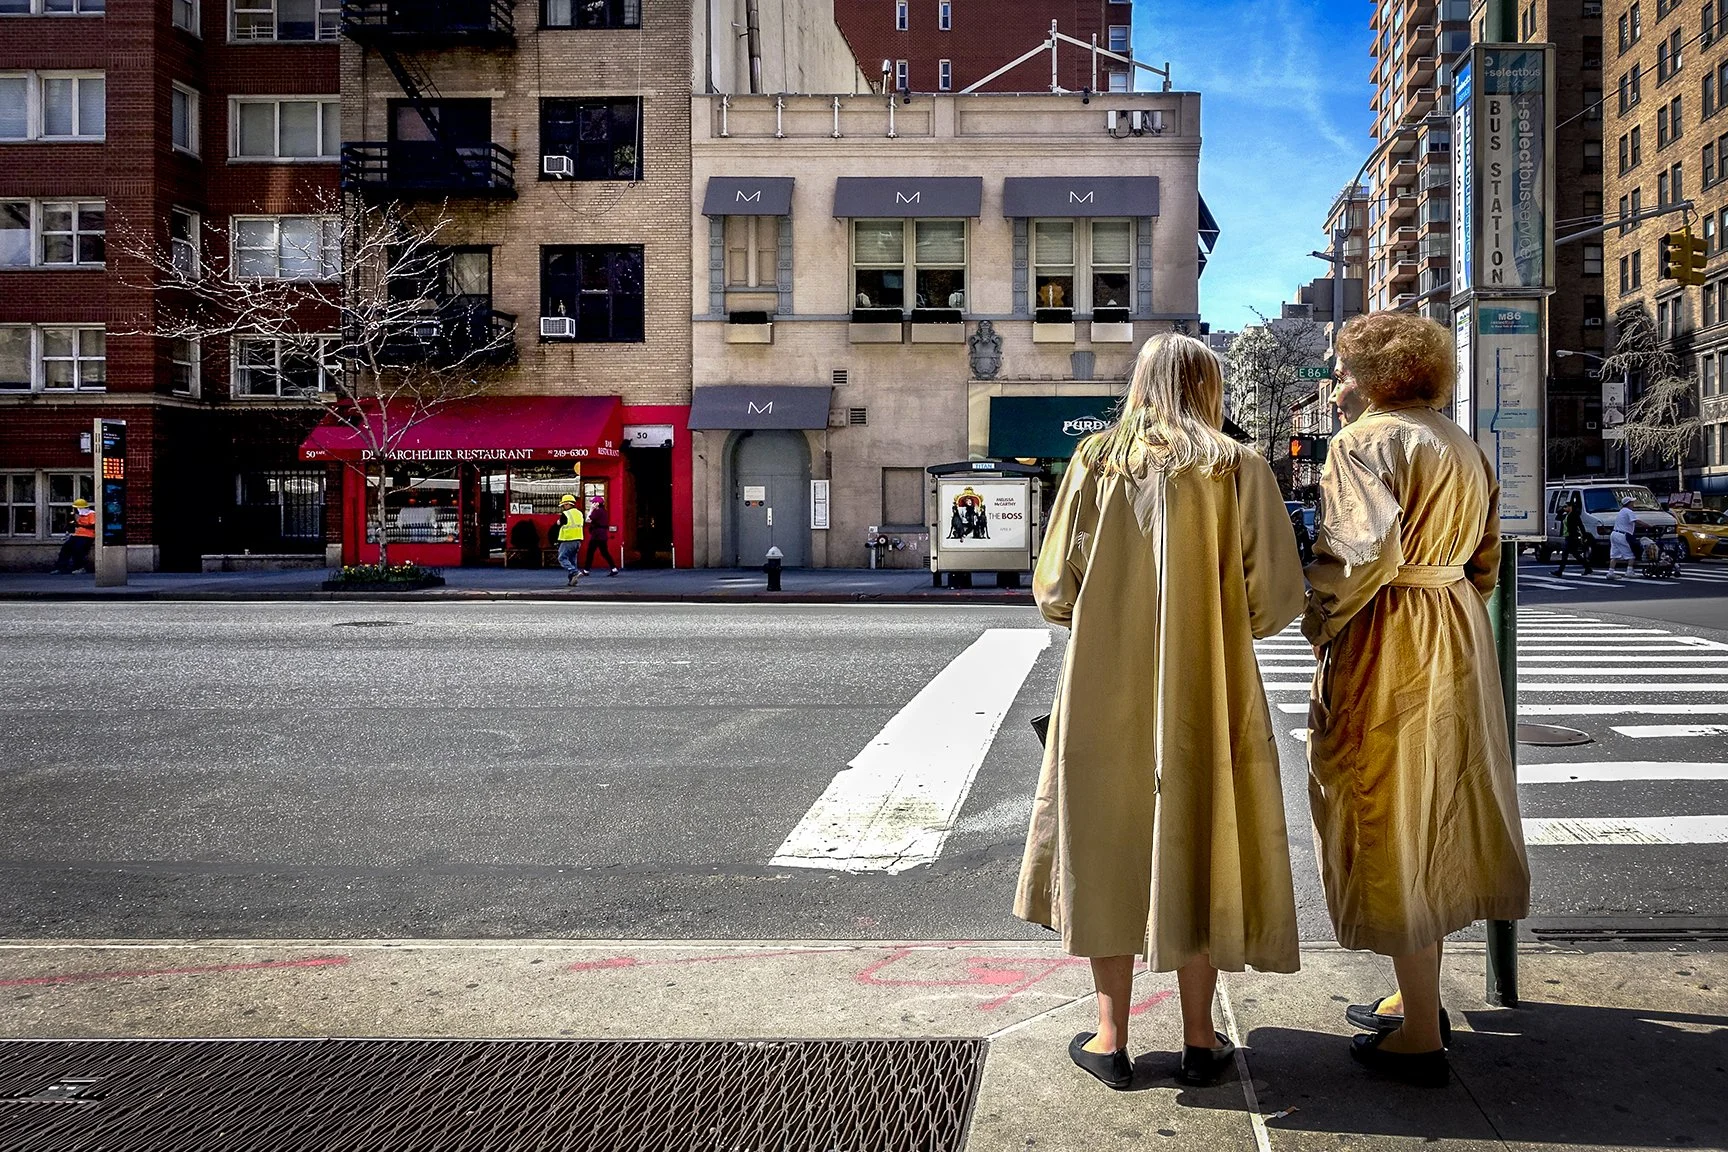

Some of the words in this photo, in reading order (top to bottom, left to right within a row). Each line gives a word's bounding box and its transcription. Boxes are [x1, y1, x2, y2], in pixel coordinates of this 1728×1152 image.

[1489, 100, 1502, 151] BUS
[735, 190, 761, 202] M
[896, 191, 920, 203] M
[1069, 190, 1094, 203] M
[1490, 162, 1504, 284] STATION
[1498, 311, 1522, 321] M86
[1299, 368, 1306, 378] E
[1307, 368, 1321, 378] 86
[747, 401, 773, 414] M
[305, 450, 316, 459] 50
[361, 449, 453, 460] DARCHELIER
[456, 449, 534, 460] RESTAURANT
[553, 448, 589, 458] 249-6300
[511, 503, 519, 512] A
[989, 512, 1001, 520] THE
[1001, 512, 1023, 520] BOSS
